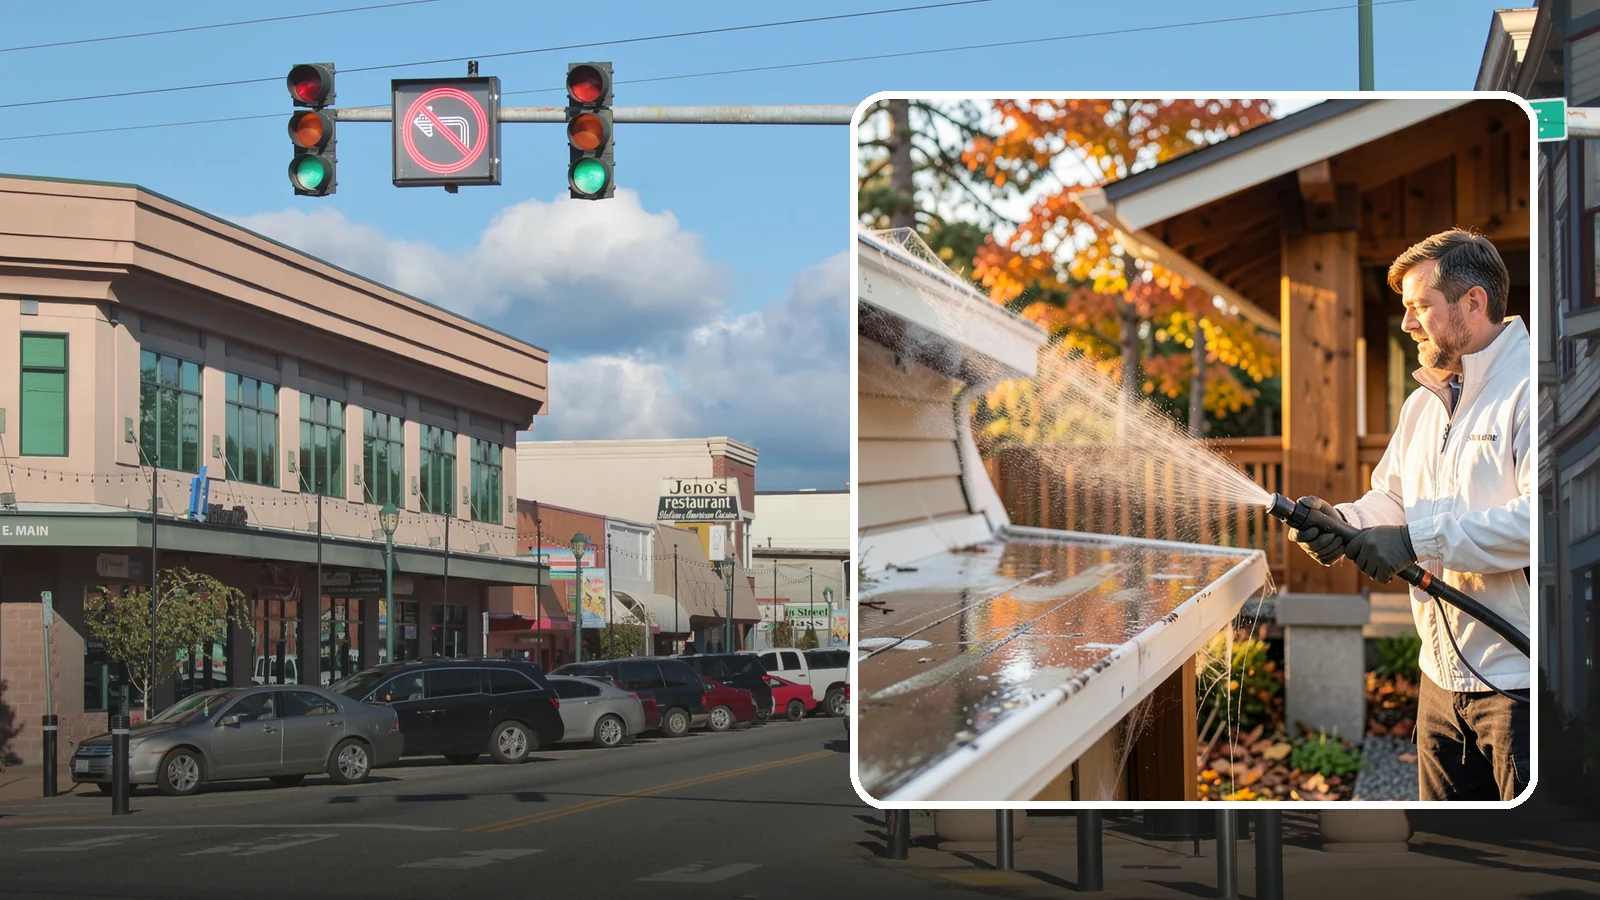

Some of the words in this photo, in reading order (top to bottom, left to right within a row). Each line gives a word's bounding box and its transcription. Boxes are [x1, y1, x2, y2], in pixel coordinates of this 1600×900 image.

[670, 480, 727, 494] Jeno's
[665, 496, 731, 509] restaurant
[659, 510, 681, 519] Italian
[686, 510, 714, 519] American
[715, 509, 737, 519] Cuisine
[2, 525, 13, 536] E.
[16, 525, 49, 536] MAIN
[797, 607, 828, 616] Street
